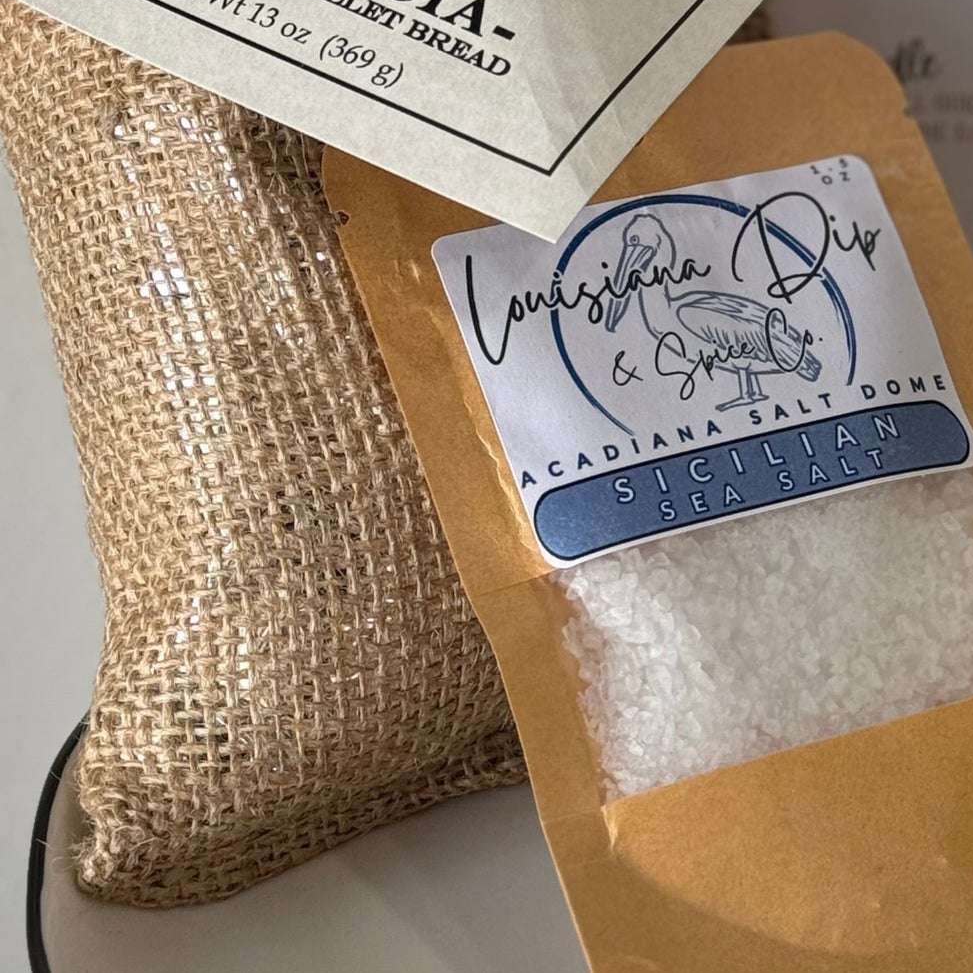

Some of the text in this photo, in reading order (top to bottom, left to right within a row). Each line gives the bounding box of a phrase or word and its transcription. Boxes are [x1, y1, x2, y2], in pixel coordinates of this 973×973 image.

[252, 0, 280, 30] 13
[280, 20, 310, 47] oz
[319, 34, 377, 77] (369
[373, 62, 406, 90] g)
[405, 21, 511, 79] BREAD
[466, 191, 881, 365] Louisiana Dip
[611, 350, 644, 387] &
[654, 331, 756, 400] Spice
[519, 374, 946, 490] ACADIANA SALT DOME
[612, 413, 900, 504] SICILIAN
[659, 448, 884, 521] SEA SALT
